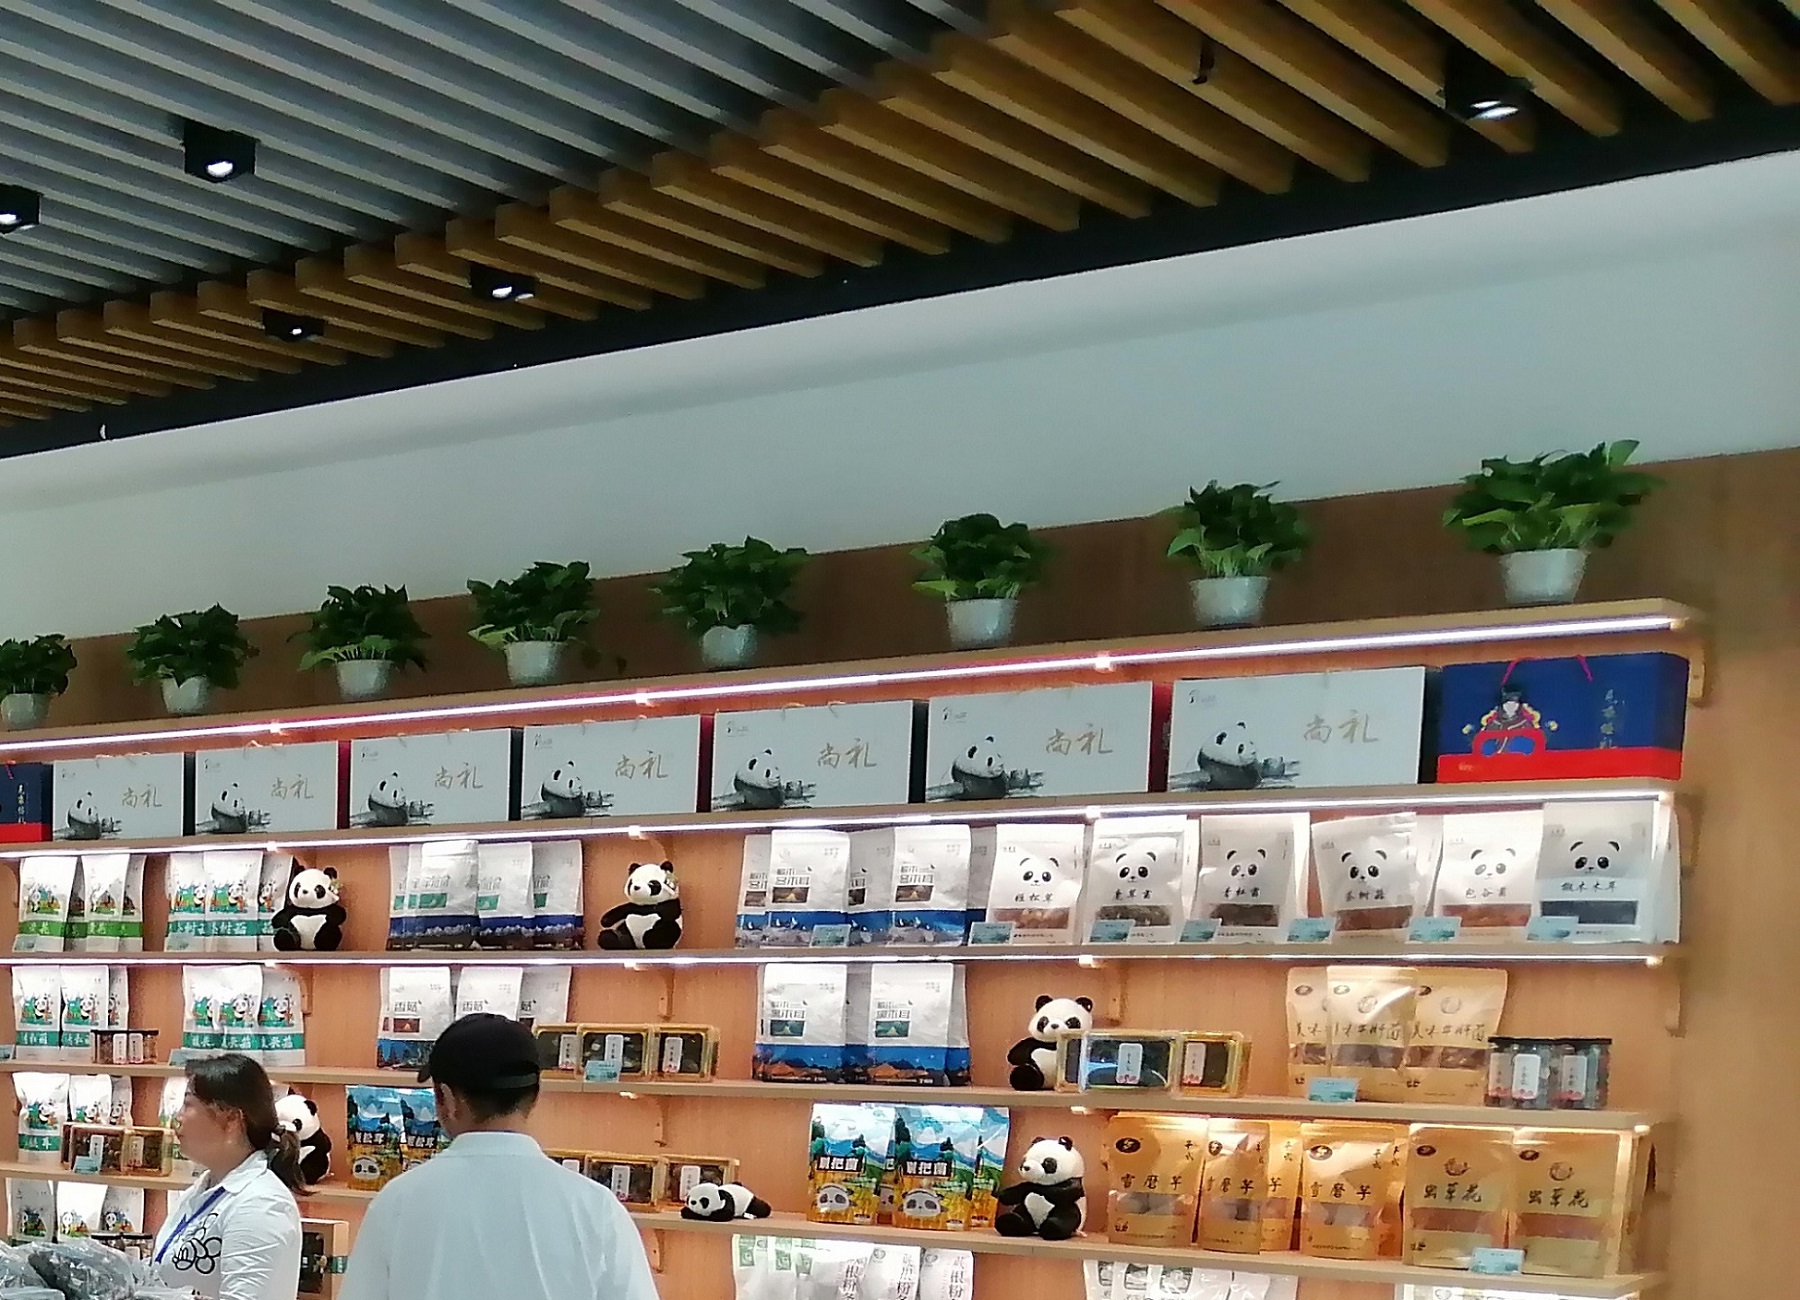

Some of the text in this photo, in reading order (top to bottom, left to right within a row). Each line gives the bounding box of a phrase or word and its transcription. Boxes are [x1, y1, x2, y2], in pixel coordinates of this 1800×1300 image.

[1045, 722, 1114, 756] 尚礼
[1304, 709, 1381, 744] 尚礼
[614, 750, 669, 780] 尚礼
[817, 738, 878, 769] 尚礼
[270, 773, 314, 800] 尚礼
[434, 762, 484, 790] 尚礼
[121, 783, 163, 808] 尚礼
